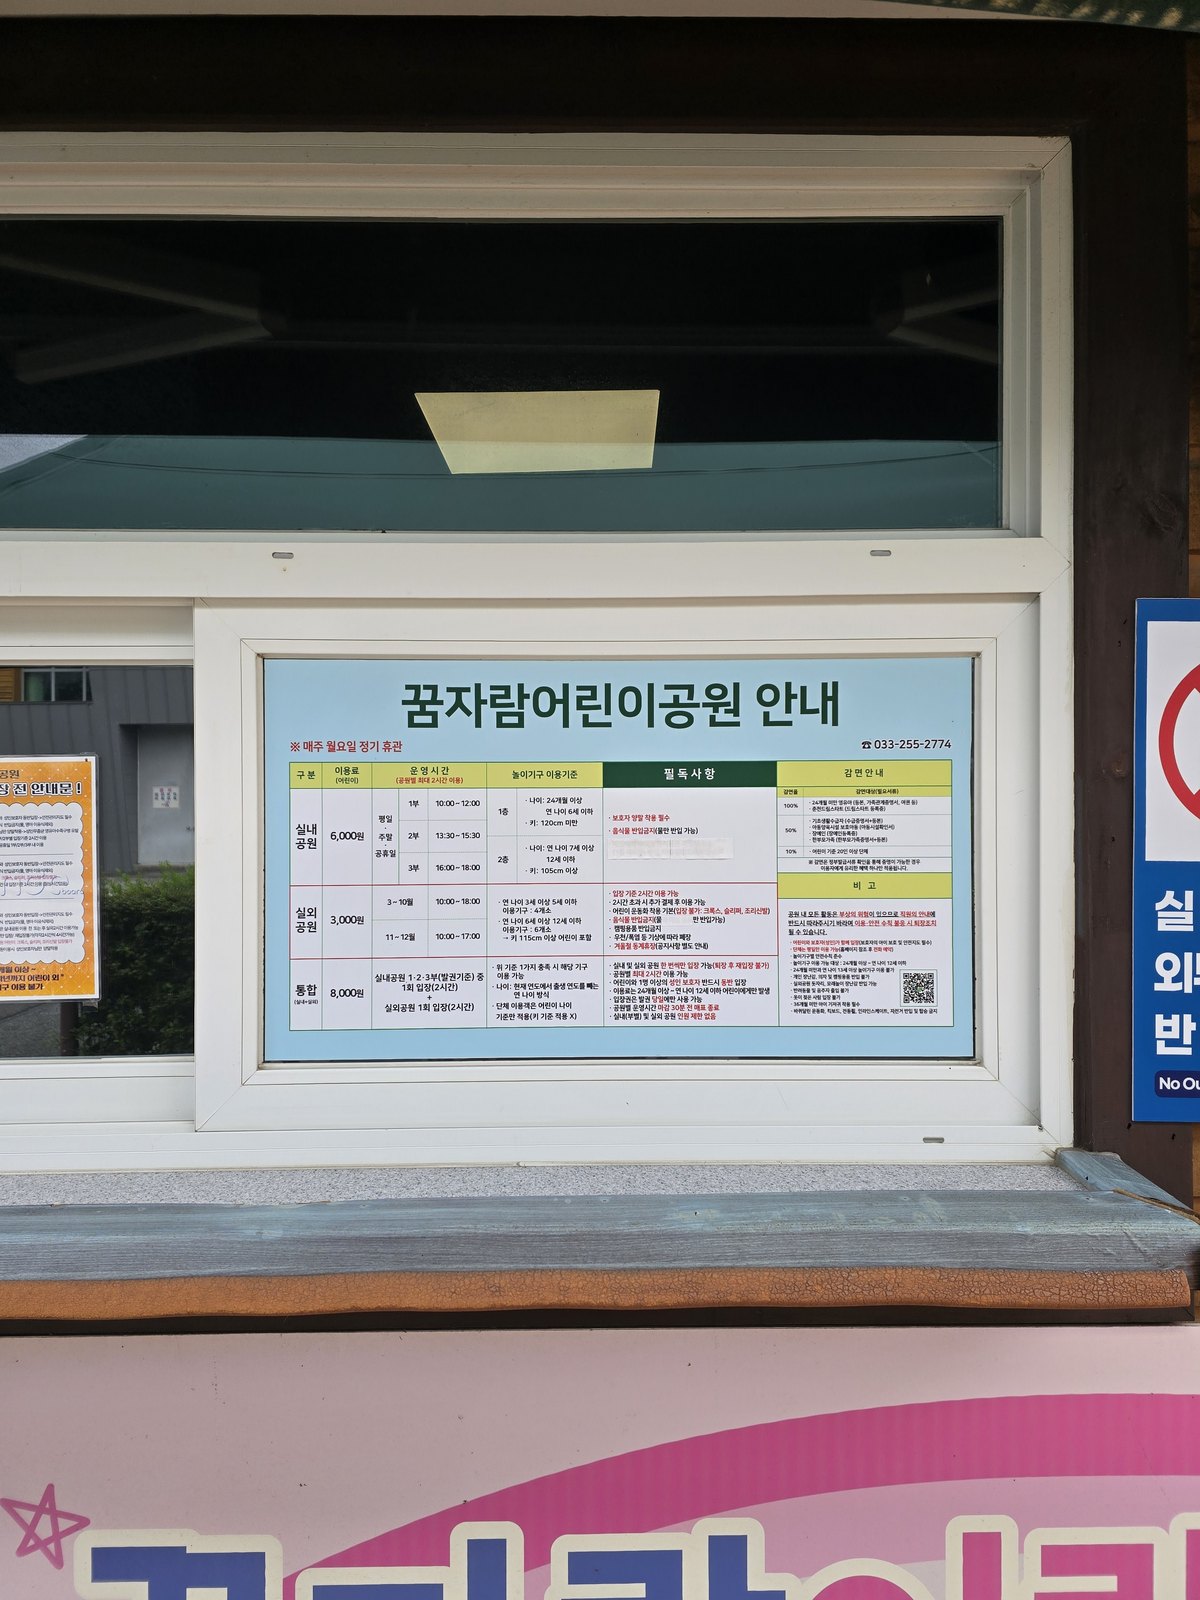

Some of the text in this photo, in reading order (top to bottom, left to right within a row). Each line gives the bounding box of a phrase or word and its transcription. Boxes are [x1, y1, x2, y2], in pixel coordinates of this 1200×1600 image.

[402, 681, 838, 729] 꿈자람어린이공원 안내
[303, 741, 402, 752] 매주 월요일 정기 휴관
[874, 740, 952, 749] 033-255-2774
[335, 766, 359, 775] 이용료
[512, 770, 578, 779] 놀이기구 이용기준
[14, 783, 26, 795] 전
[31, 783, 72, 795] 안내문
[378, 815, 393, 823] 평일
[644, 814, 657, 822] 착용
[296, 824, 317, 835] 실내
[330, 832, 364, 841] 6,000원
[408, 832, 419, 840] 2부
[296, 838, 317, 849] 공원
[375, 850, 396, 858] 공휴일
[296, 907, 317, 919] 실외
[1155, 890, 1194, 932] 실
[330, 916, 364, 925] 3,000원
[296, 921, 317, 933] 공원
[375, 974, 405, 982] 실내공원
[476, 973, 484, 981] 중
[1154, 952, 1200, 994] 외
[295, 984, 317, 996] 통합
[402, 983, 458, 992] 1회 입장(2시간)
[330, 989, 364, 998] 8,000원
[385, 1004, 415, 1012] 실외공원
[433, 1003, 474, 1012] 입장(2시간)
[1160, 1077, 1180, 1090] No
